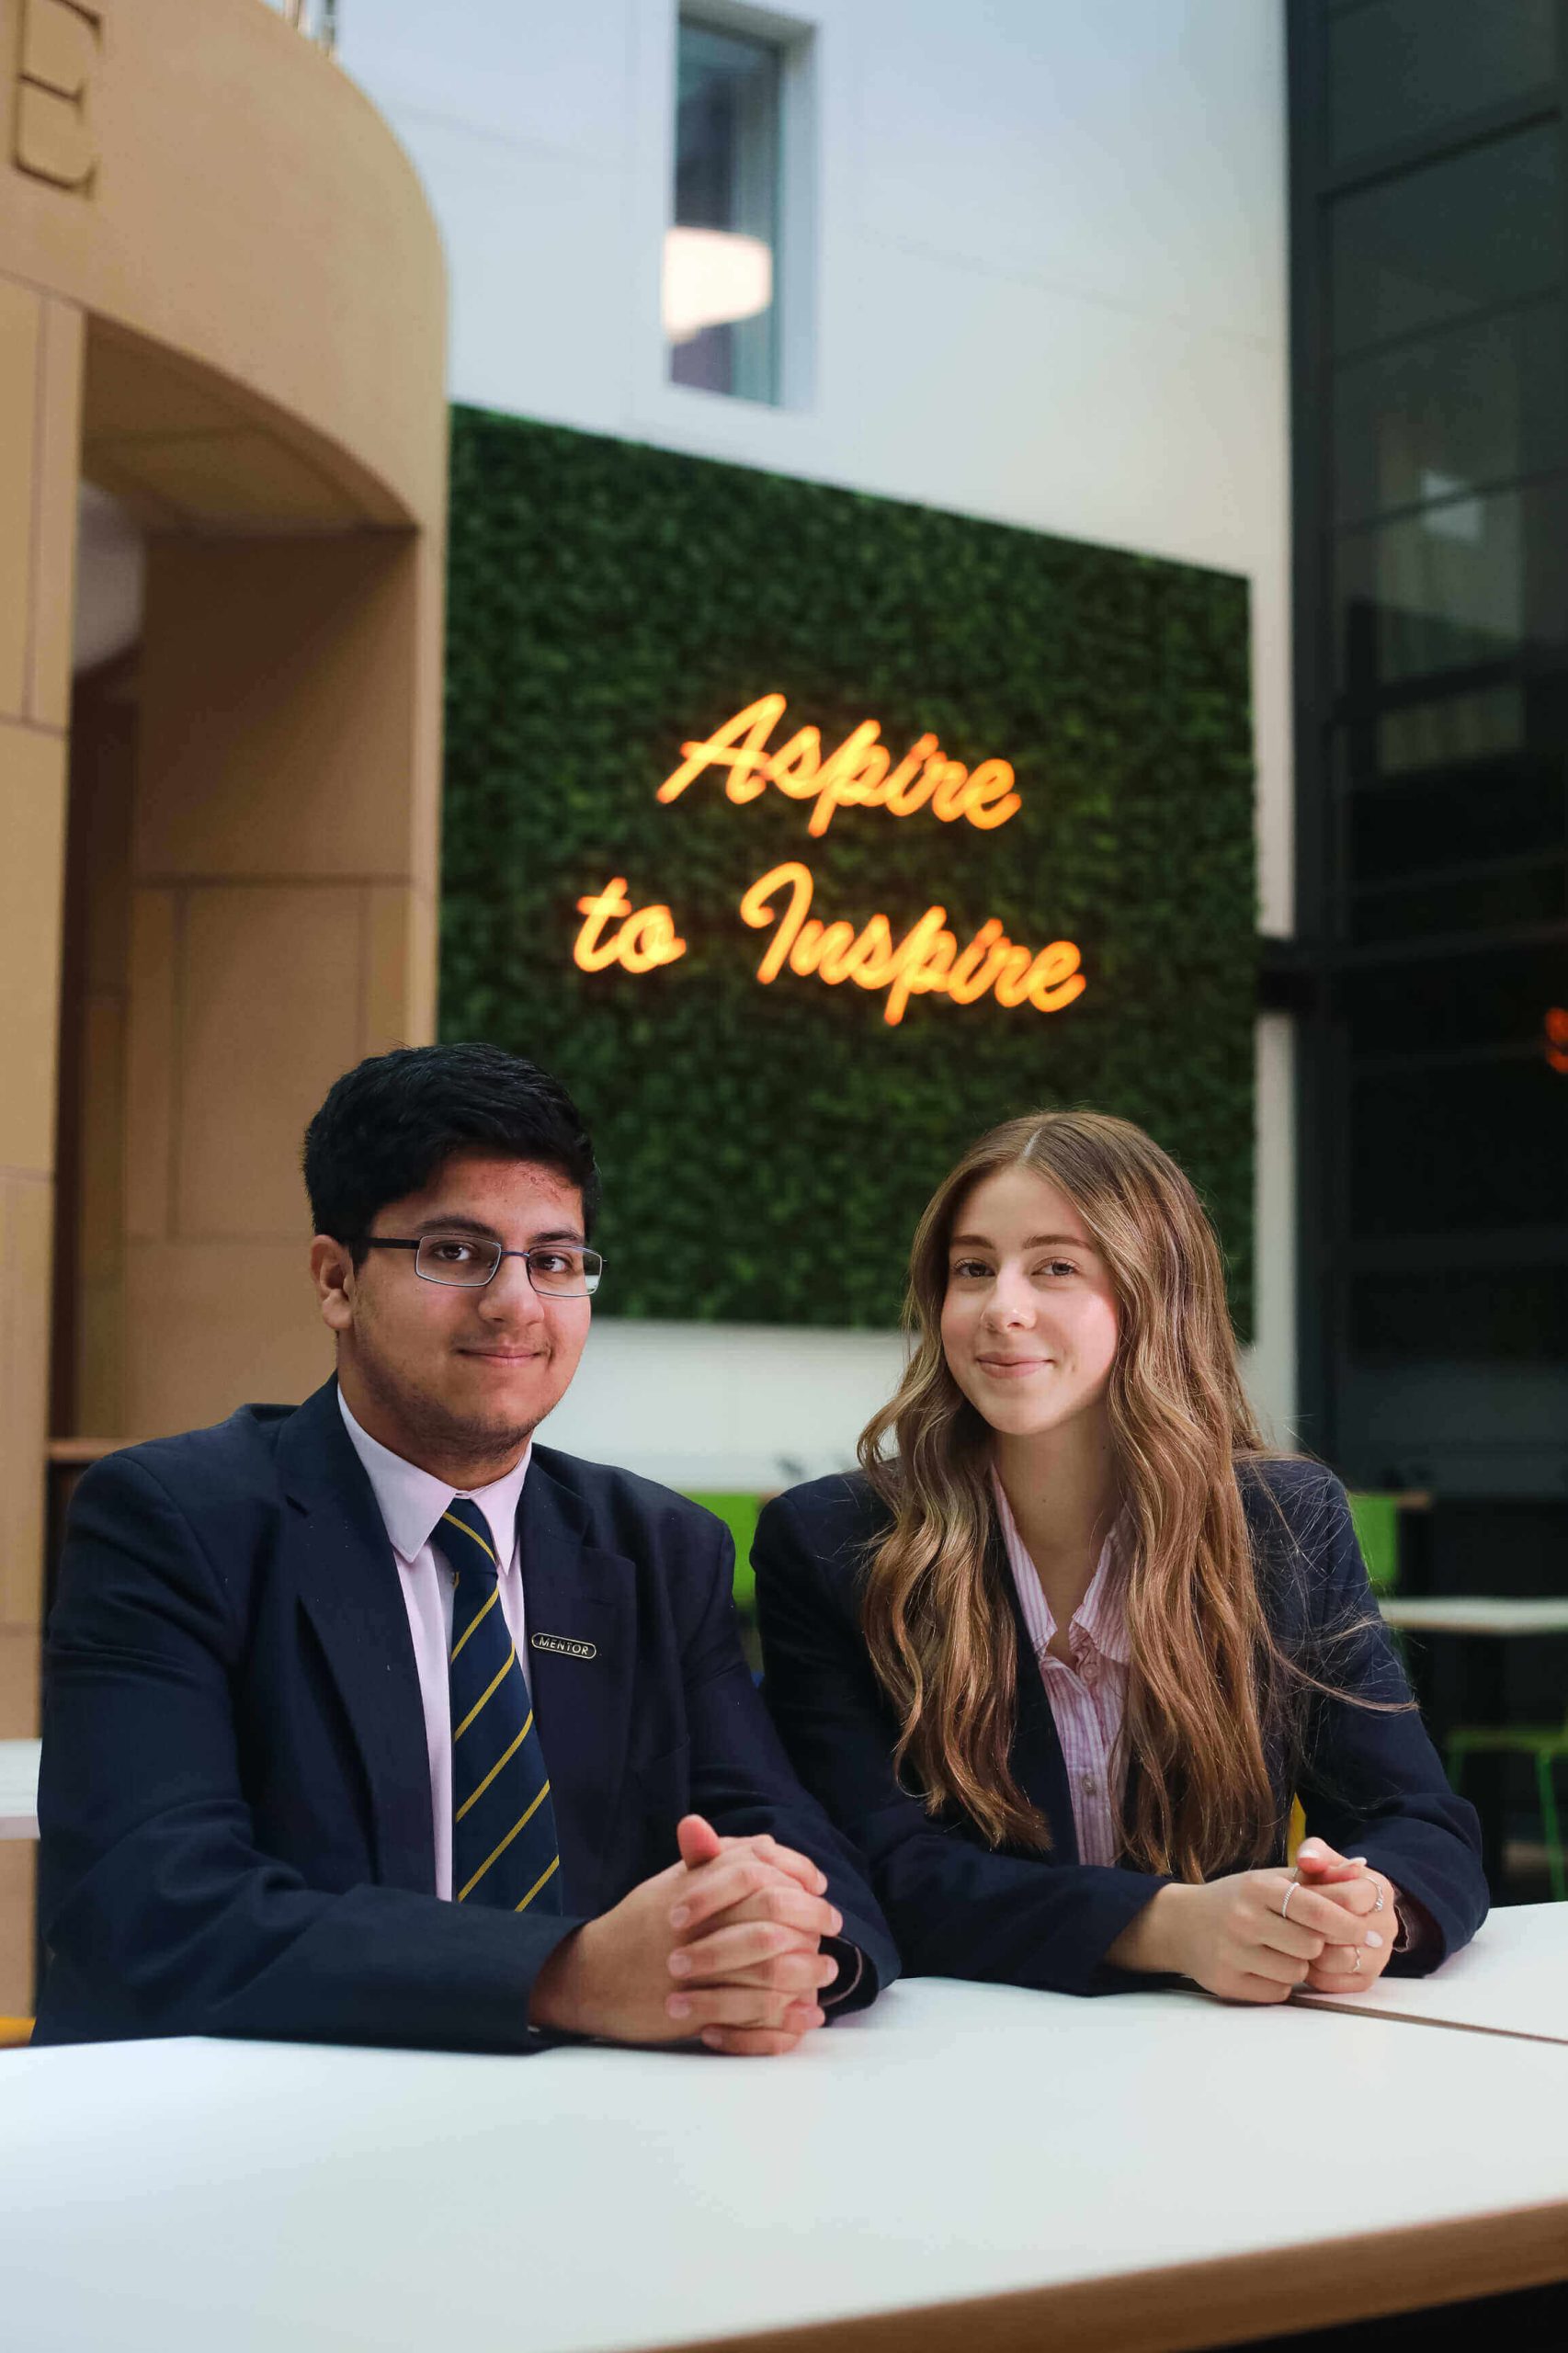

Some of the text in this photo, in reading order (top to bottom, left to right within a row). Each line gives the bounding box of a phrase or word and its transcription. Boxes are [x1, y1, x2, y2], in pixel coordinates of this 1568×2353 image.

[656, 693, 1021, 837] Aspire
[574, 861, 1086, 1026] to Inspire
[539, 1636, 589, 1655] MENTOR
